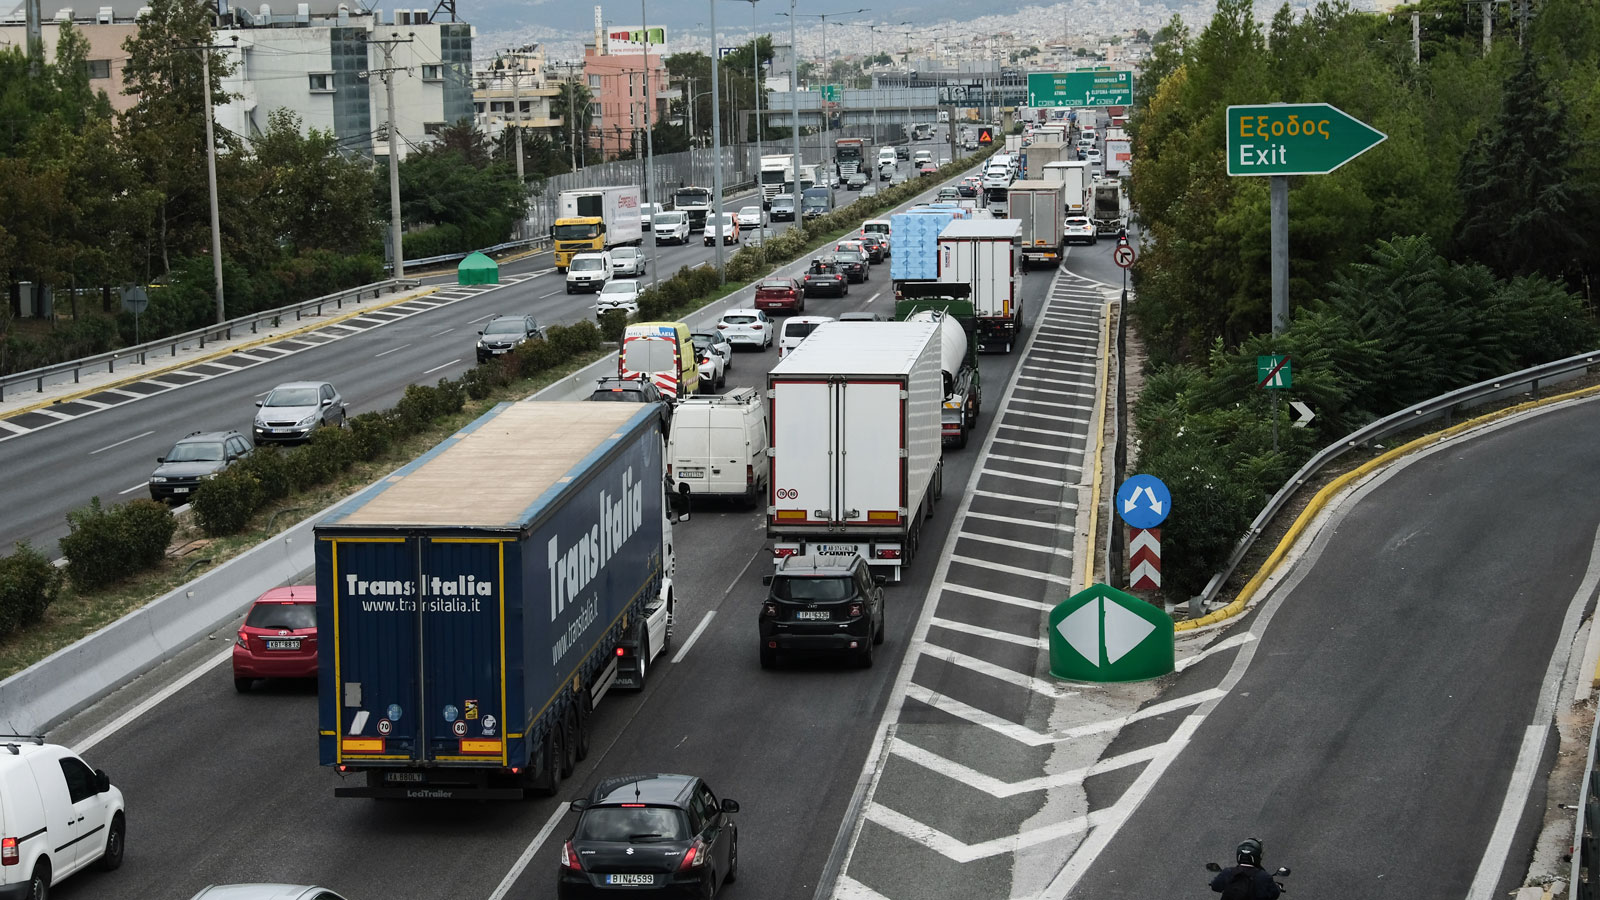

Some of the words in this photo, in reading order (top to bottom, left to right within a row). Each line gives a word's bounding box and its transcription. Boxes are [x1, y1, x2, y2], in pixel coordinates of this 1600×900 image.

[1239, 115, 1330, 141] Εξοδος
[1239, 144, 1287, 166] Exit
[551, 591, 599, 667] www.transitalia.it
[380, 723, 389, 731] 70
[456, 724, 465, 732] 80
[407, 790, 453, 798] LeciTrailer
